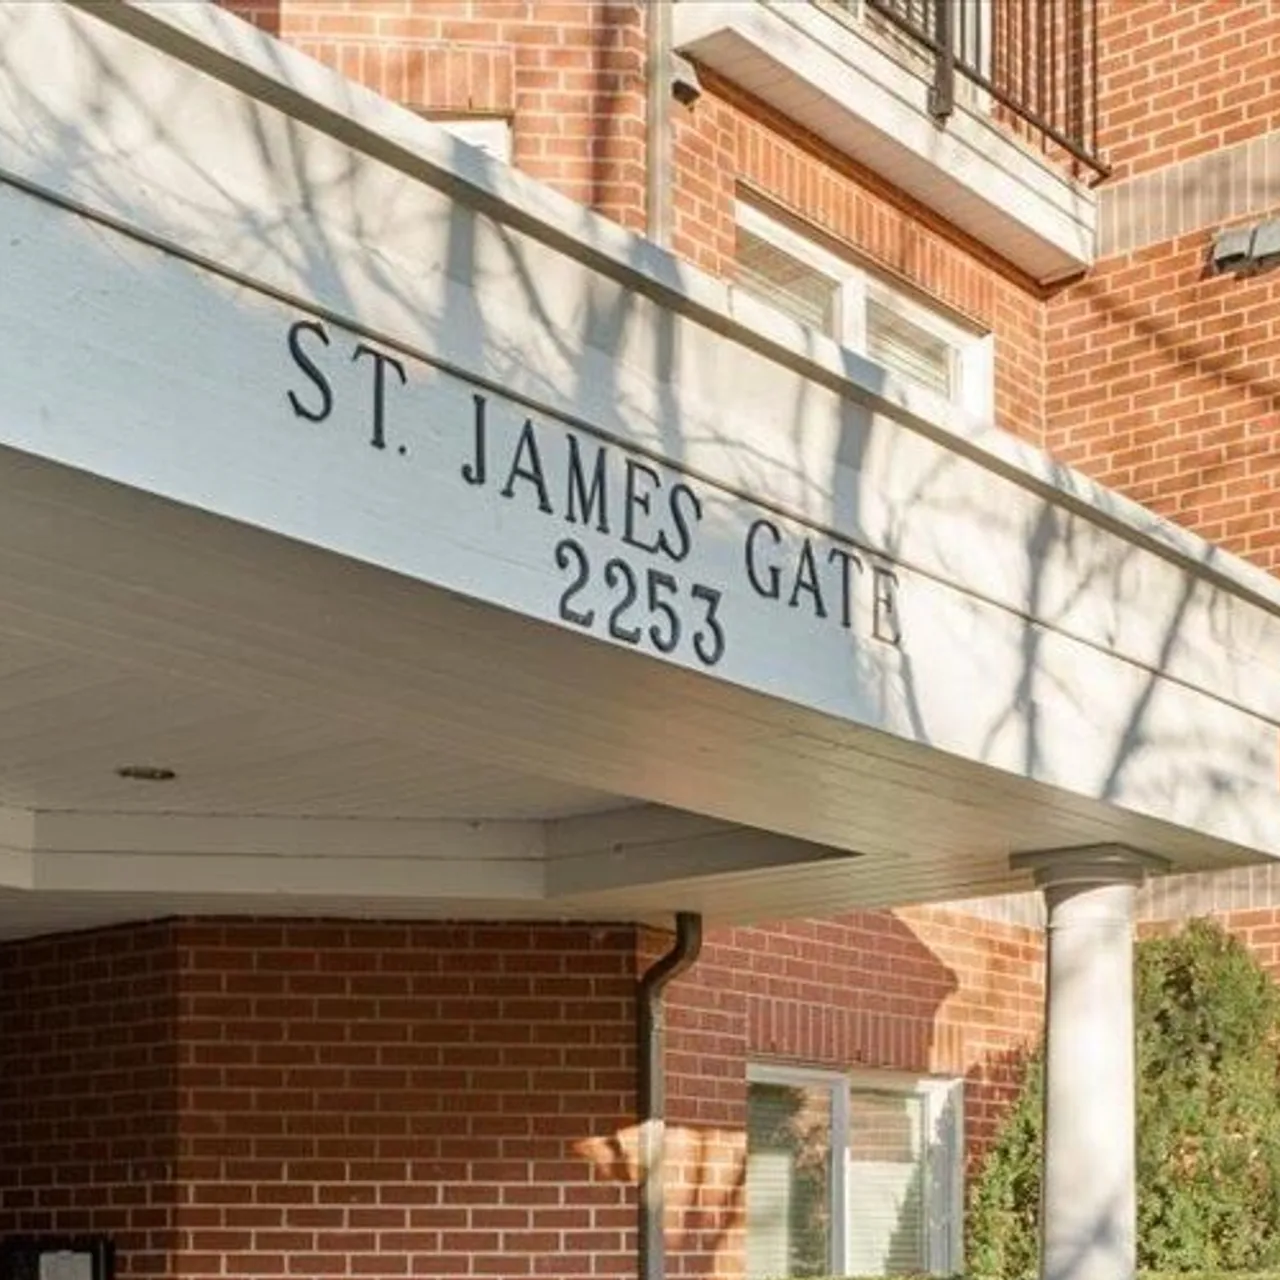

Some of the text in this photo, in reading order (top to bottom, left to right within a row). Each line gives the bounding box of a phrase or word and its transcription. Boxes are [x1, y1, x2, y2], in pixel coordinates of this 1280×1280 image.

[286, 320, 904, 647] ST. JAMES GATE
[553, 538, 726, 666] 2253
